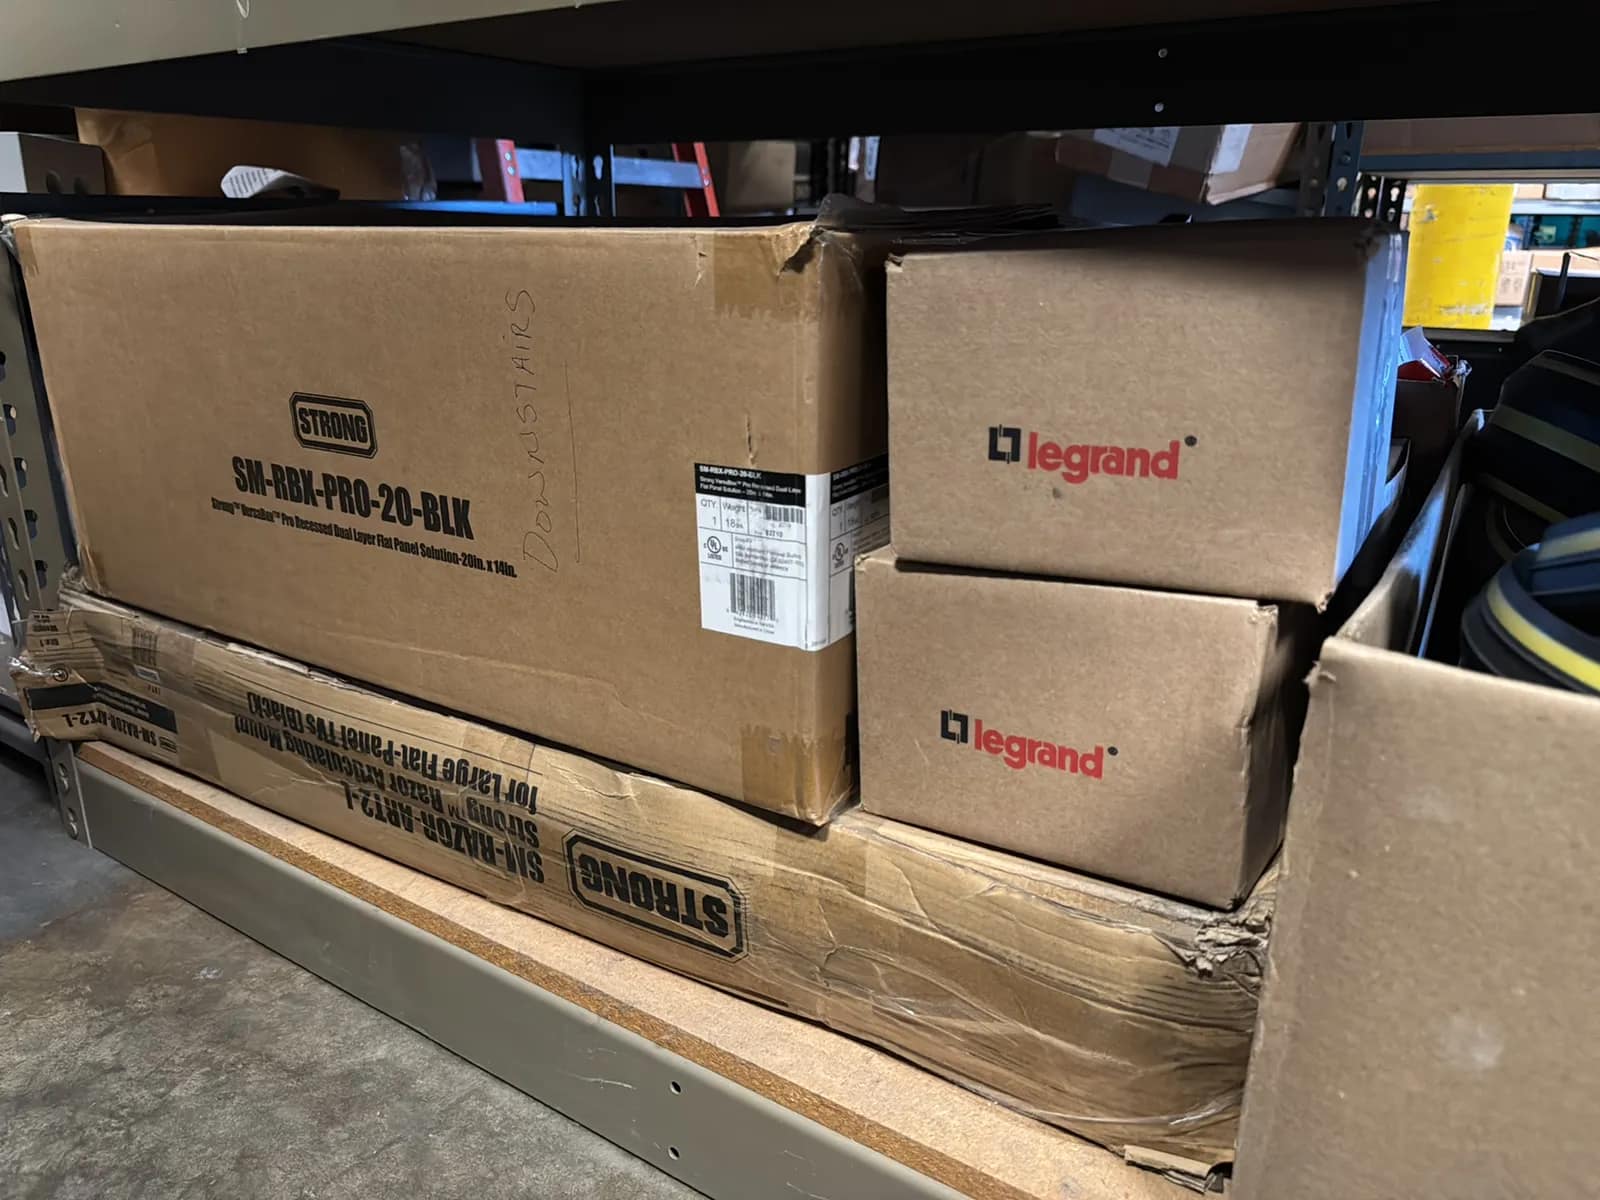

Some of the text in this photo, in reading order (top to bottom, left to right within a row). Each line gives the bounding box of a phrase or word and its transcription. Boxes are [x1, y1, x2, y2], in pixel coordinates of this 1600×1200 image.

[298, 407, 369, 443] STRONG
[231, 455, 475, 541] SM-RBX-PRO-20-BLK
[700, 499, 717, 509] QTY
[281, 513, 295, 527] Pro
[294, 516, 334, 537] Recessed
[334, 524, 352, 541] Dual
[353, 528, 376, 548] Layer
[376, 533, 394, 550] Flat
[393, 537, 419, 556] Panel
[486, 559, 494, 573] x
[493, 559, 518, 578] 14in.
[234, 713, 284, 751] Mount
[305, 713, 340, 748] TVs
[339, 724, 438, 781] Flat-Panel
[282, 729, 385, 791] Articulating
[442, 757, 503, 803] Large
[389, 772, 445, 814] Razor
[504, 778, 538, 815] for
[578, 853, 729, 938] STRONG
